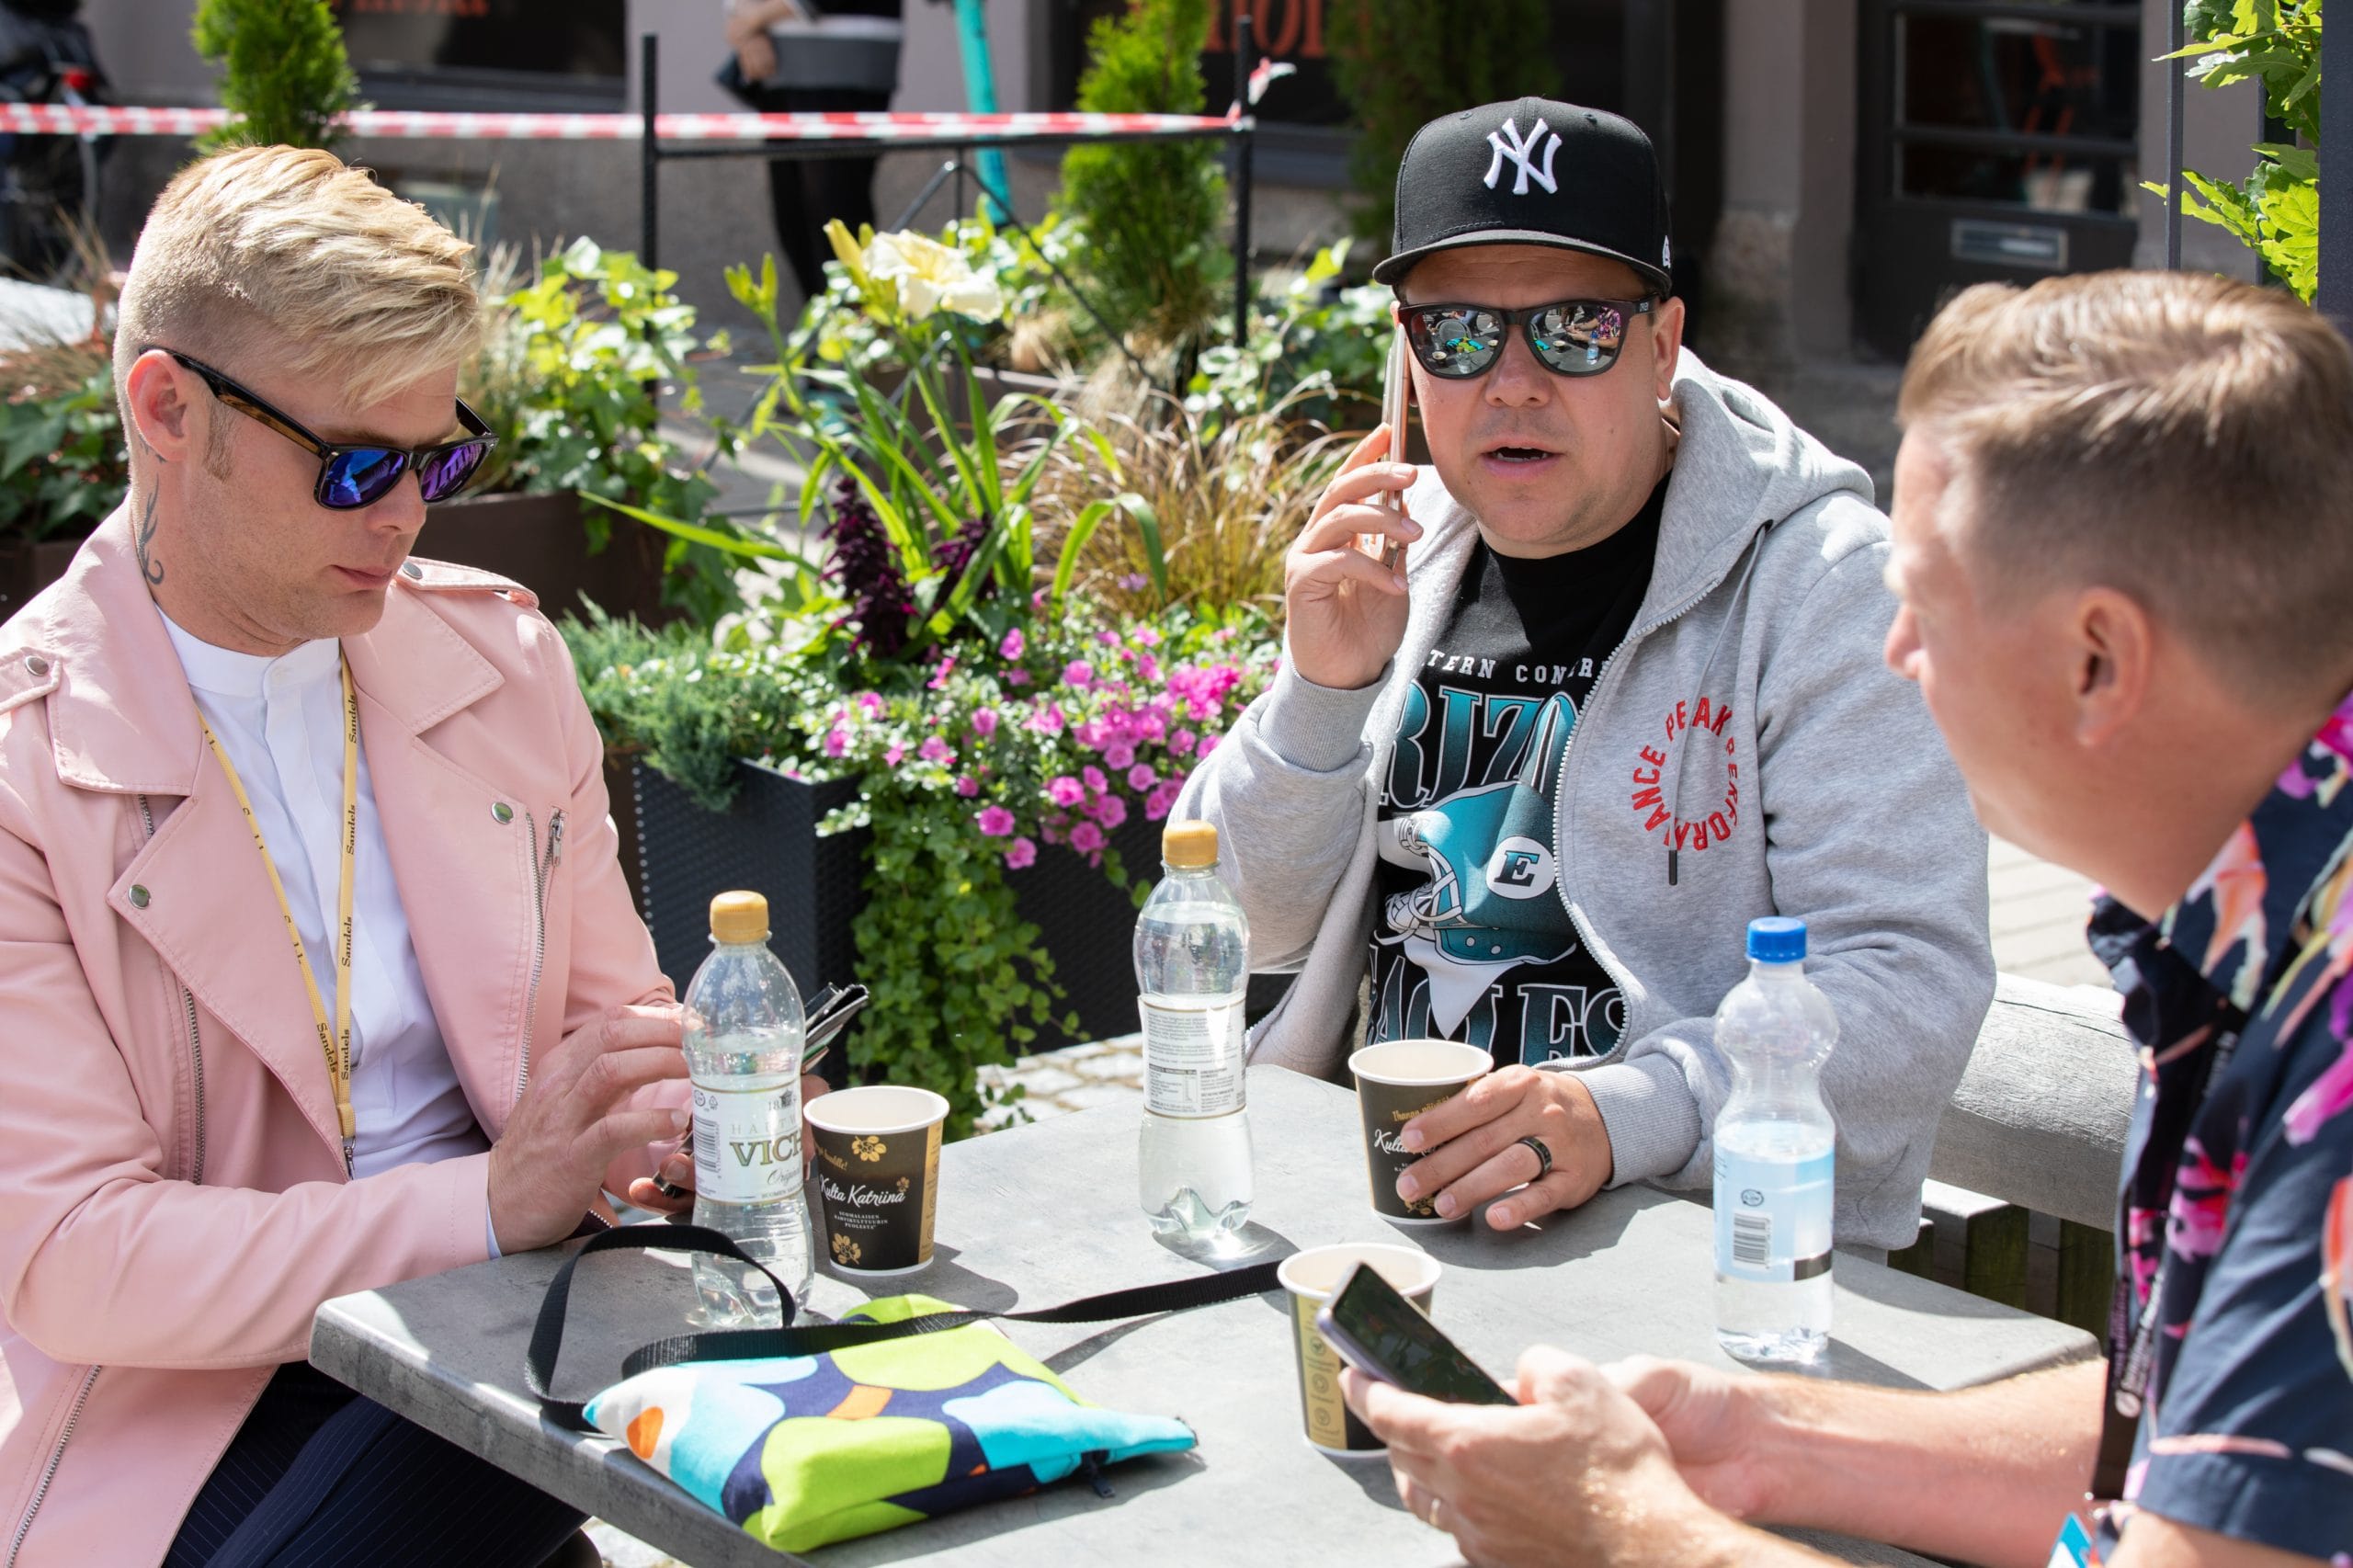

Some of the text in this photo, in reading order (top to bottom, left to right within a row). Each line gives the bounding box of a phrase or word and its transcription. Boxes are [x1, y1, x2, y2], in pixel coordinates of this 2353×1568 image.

[1483, 118, 1562, 195] NY
[1422, 649, 1496, 679] TERN
[347, 694, 358, 744] Sandels
[1665, 697, 1733, 742] PEAK
[346, 804, 356, 855] Sandels
[1494, 850, 1540, 887] E
[341, 915, 352, 967] Sandels
[317, 1022, 337, 1074] Sandels
[340, 1028, 350, 1081] Sandels
[820, 1174, 846, 1201] Kulta
[847, 1184, 906, 1208] Katriina
